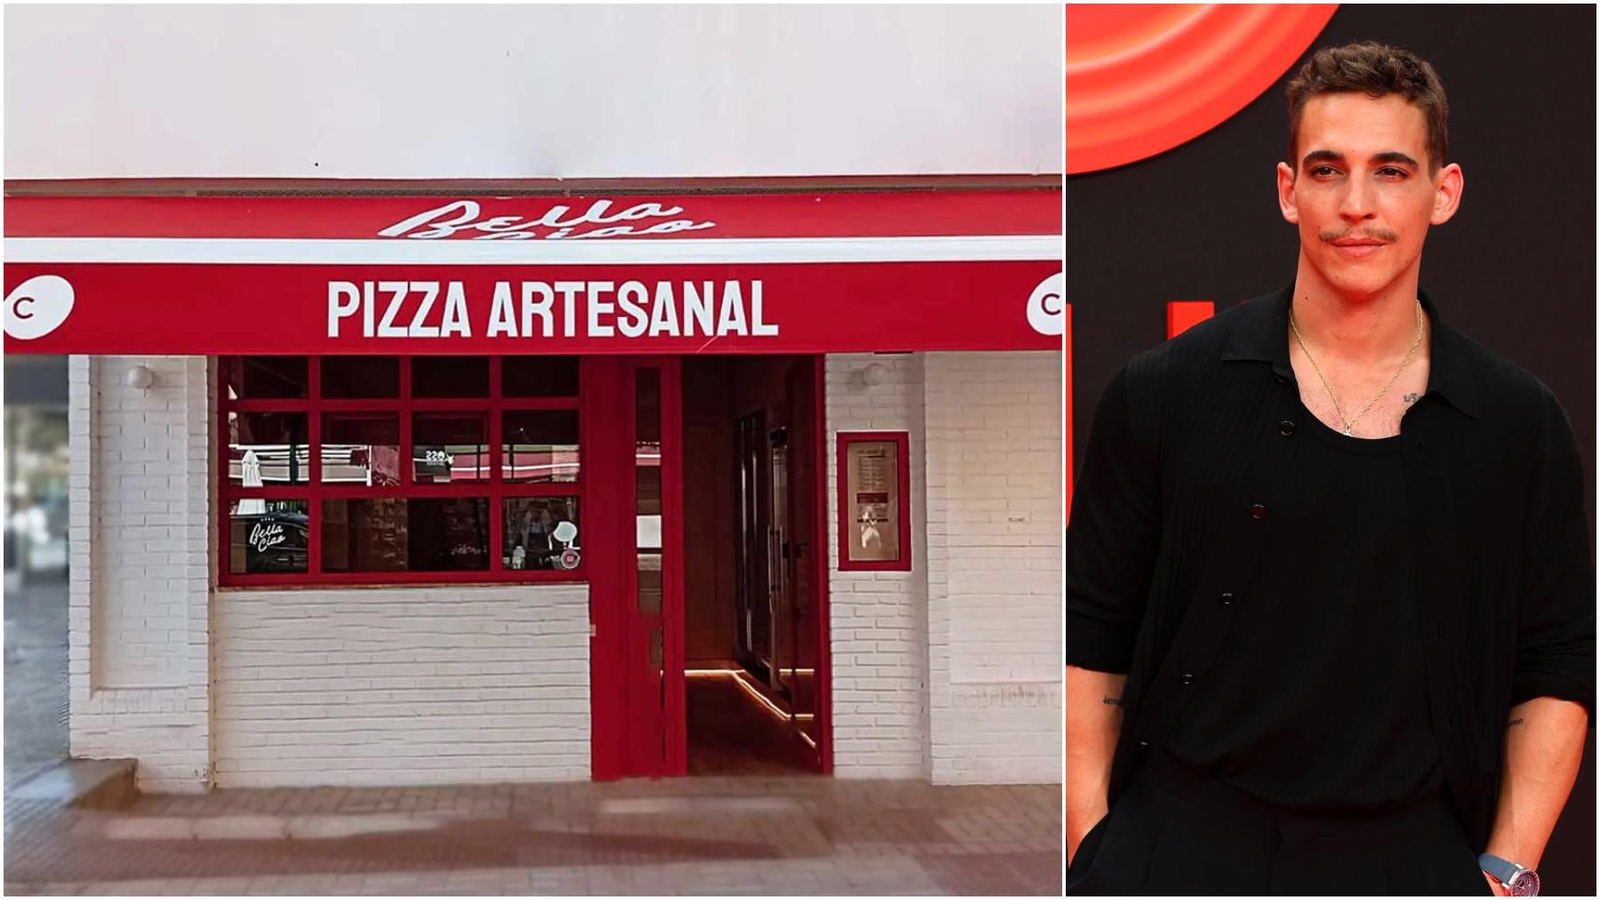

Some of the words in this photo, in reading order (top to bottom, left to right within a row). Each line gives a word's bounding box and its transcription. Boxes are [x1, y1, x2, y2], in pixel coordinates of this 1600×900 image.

[377, 200, 684, 239] Bella
[327, 281, 472, 338] PIZZA
[486, 280, 779, 337] ARTESANAL
[249, 523, 284, 545] Bella
[258, 535, 286, 552] Ciao
